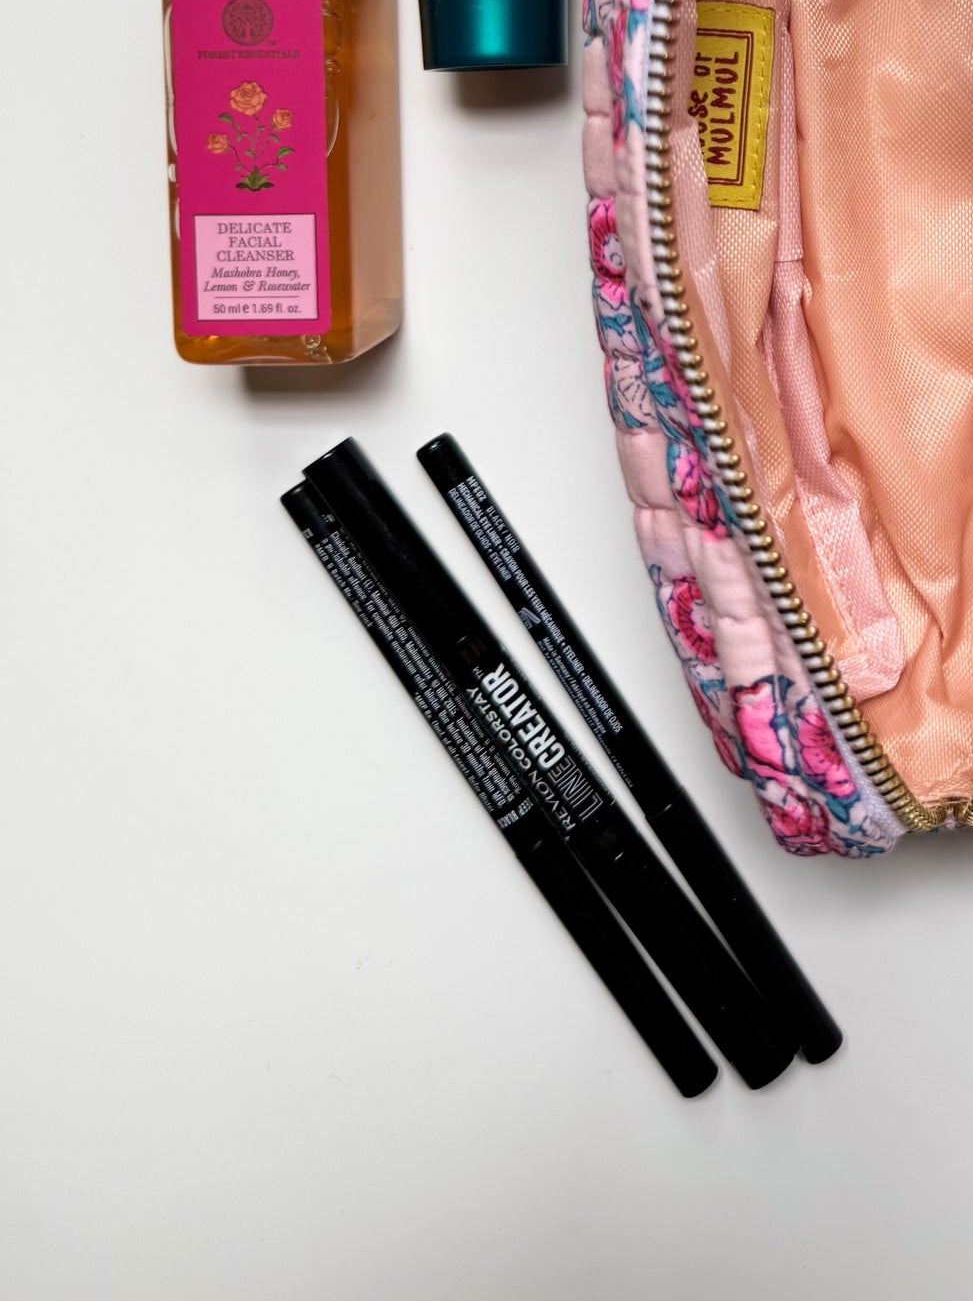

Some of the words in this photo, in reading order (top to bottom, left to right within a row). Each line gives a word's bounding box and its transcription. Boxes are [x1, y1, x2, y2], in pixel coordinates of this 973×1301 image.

[706, 51, 739, 165] MULMUL
[217, 222, 292, 234] DELICATE
[228, 236, 282, 248] FACIAL
[216, 250, 295, 262] CLEANSER
[211, 267, 262, 278] Mashobra
[266, 267, 301, 280] Honey,
[203, 281, 238, 292] Lemon
[243, 281, 255, 291] &
[258, 281, 311, 292] Rosewater
[213, 303, 226, 314] 50
[228, 303, 241, 313] ml
[252, 303, 274, 313] 1.69
[447, 486, 475, 524] DELINEADOR
[455, 481, 485, 519] MECHANICAL
[468, 520, 480, 531] DE
[484, 504, 507, 531] BLACK
[503, 532, 522, 554] NOIR
[473, 527, 492, 550] OLHOS
[498, 546, 519, 572] CRAYON
[512, 568, 529, 587] POUR
[522, 583, 536, 598] LES
[529, 594, 545, 613] YEUX
[538, 607, 567, 643] MÉCANIQUE
[389, 638, 419, 675] declaration
[541, 635, 556, 652] Made
[552, 654, 573, 679] Germany
[561, 644, 586, 674] EYELINER
[370, 589, 393, 616] Mumbai
[454, 716, 480, 747] Imitation
[487, 765, 513, 796] graphics
[581, 673, 609, 711] DELINEADOR
[602, 707, 615, 719] DE
[607, 715, 624, 734] OJOS
[445, 721, 466, 744] before
[463, 681, 534, 773] COLORSTAY
[459, 741, 472, 754] 30
[465, 751, 487, 777] months
[480, 773, 498, 793] from
[525, 767, 576, 832] REVLON
